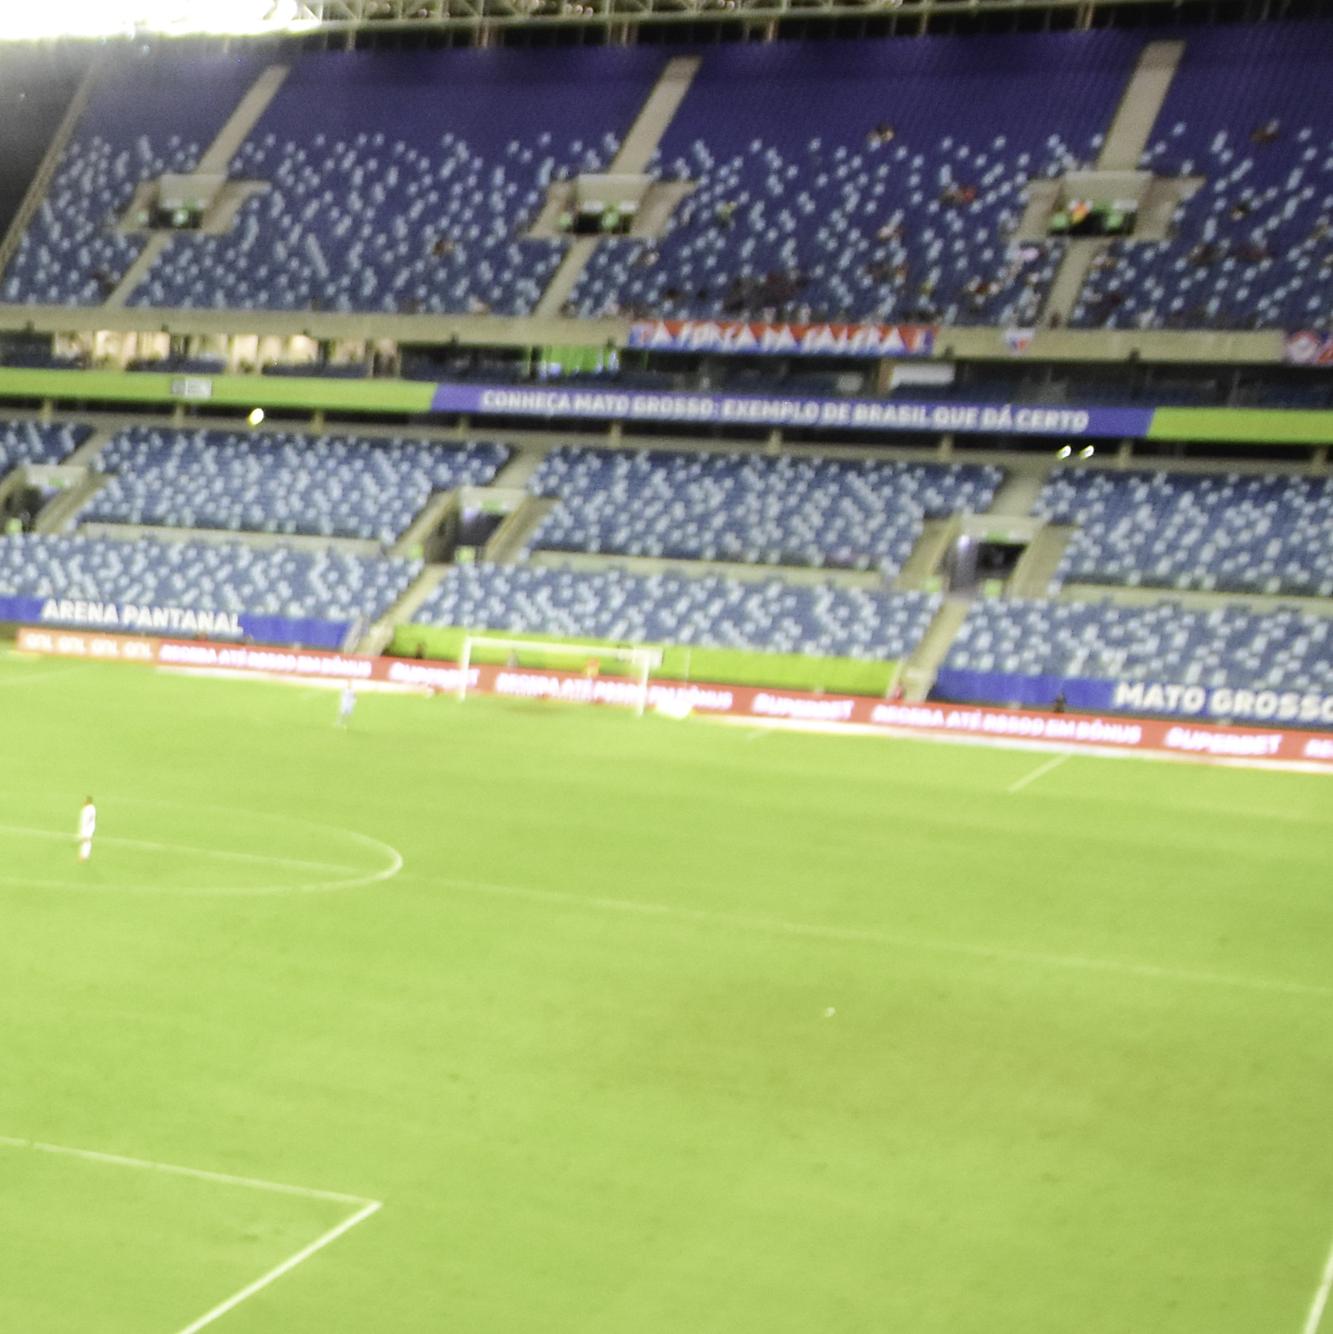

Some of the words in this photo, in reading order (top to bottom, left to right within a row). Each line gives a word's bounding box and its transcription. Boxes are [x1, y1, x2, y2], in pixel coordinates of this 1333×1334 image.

[574, 392, 631, 415] MATO
[723, 399, 820, 423] EXEMPLO
[821, 401, 851, 425] DE
[852, 402, 932, 427] BRASIL
[933, 405, 980, 429] QUE
[1015, 407, 1090, 433] CERTO
[42, 599, 119, 623] ARENA
[121, 603, 244, 636] PANTANAL
[1115, 680, 1206, 714] MATO
